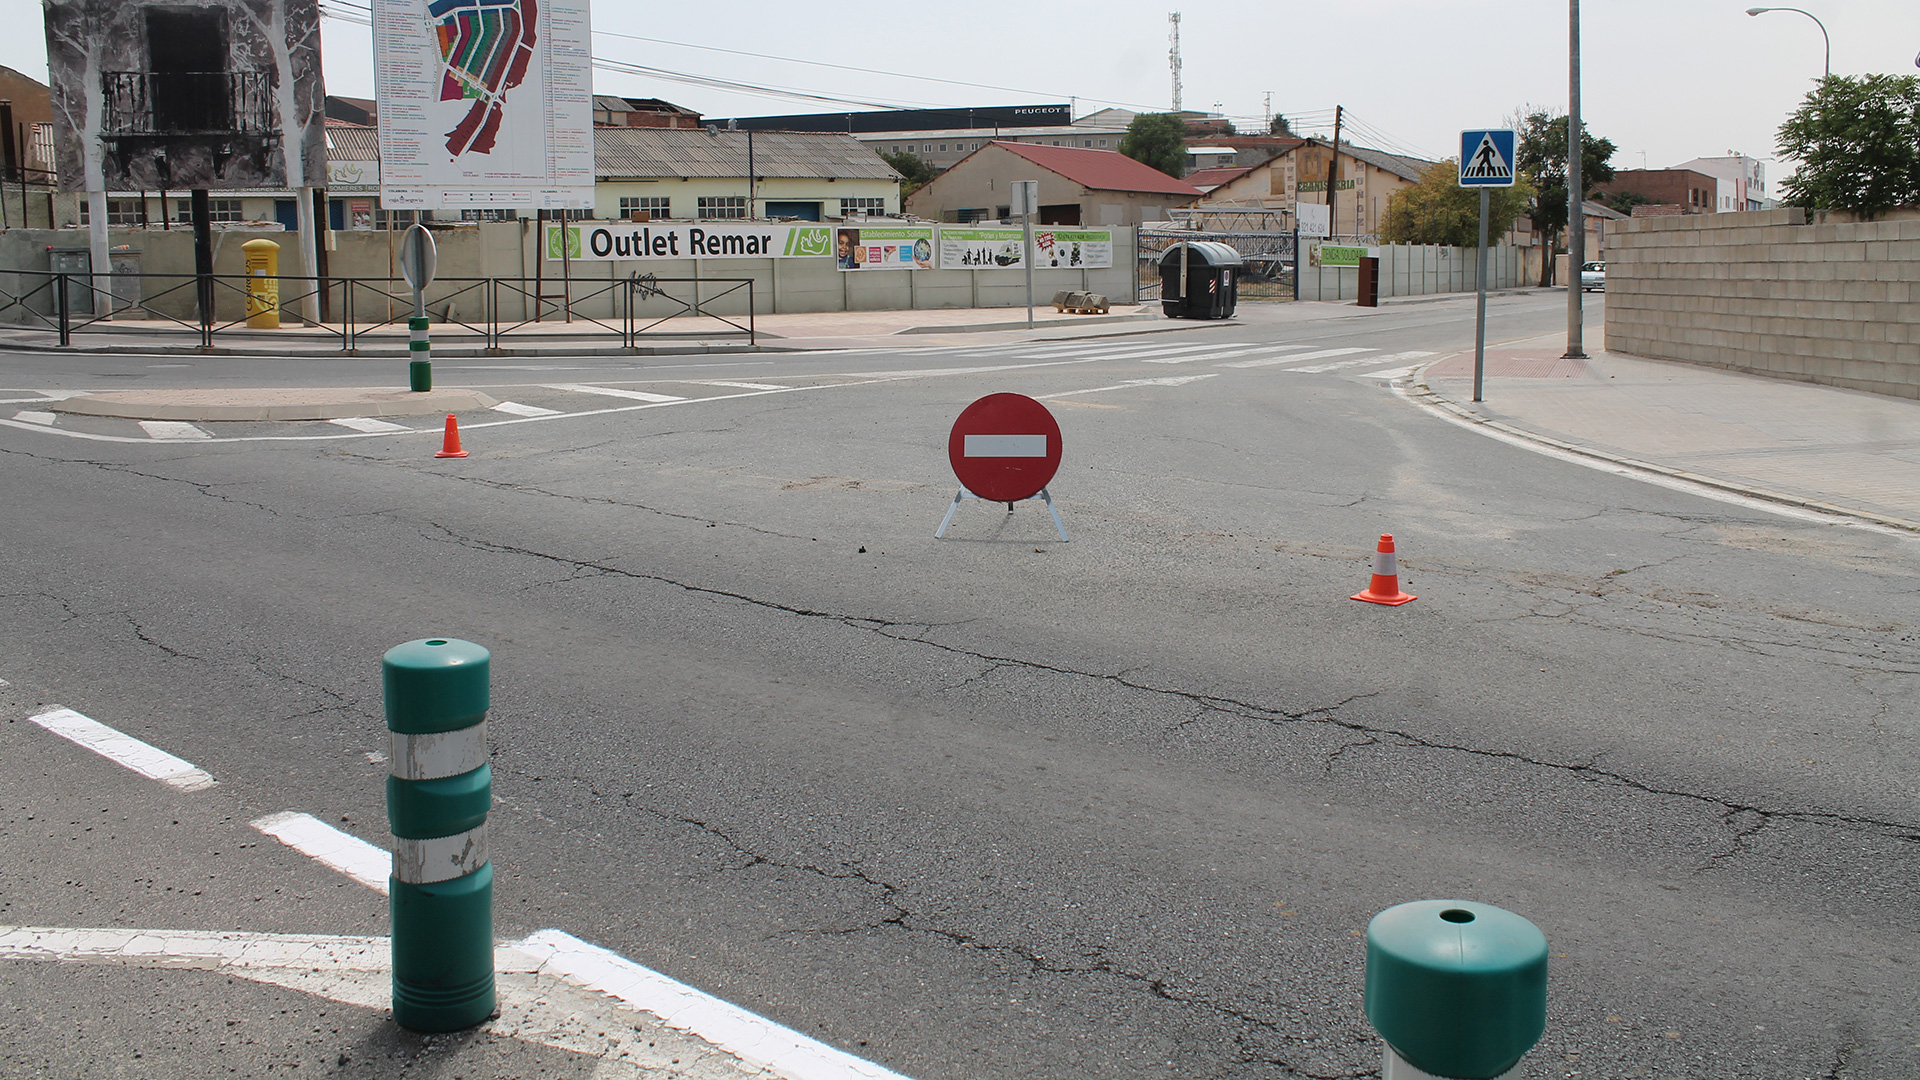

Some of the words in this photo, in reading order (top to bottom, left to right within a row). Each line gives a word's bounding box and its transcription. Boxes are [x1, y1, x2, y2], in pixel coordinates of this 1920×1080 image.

[1014, 107, 1061, 115] PEUGEOT
[1297, 179, 1355, 192] EBANISERIA
[1355, 163, 1365, 227] MUÑOZ
[861, 230, 906, 239] Establecimiento
[907, 230, 930, 238] Solidario
[590, 227, 679, 257] Outlet
[689, 228, 772, 255] Remar
